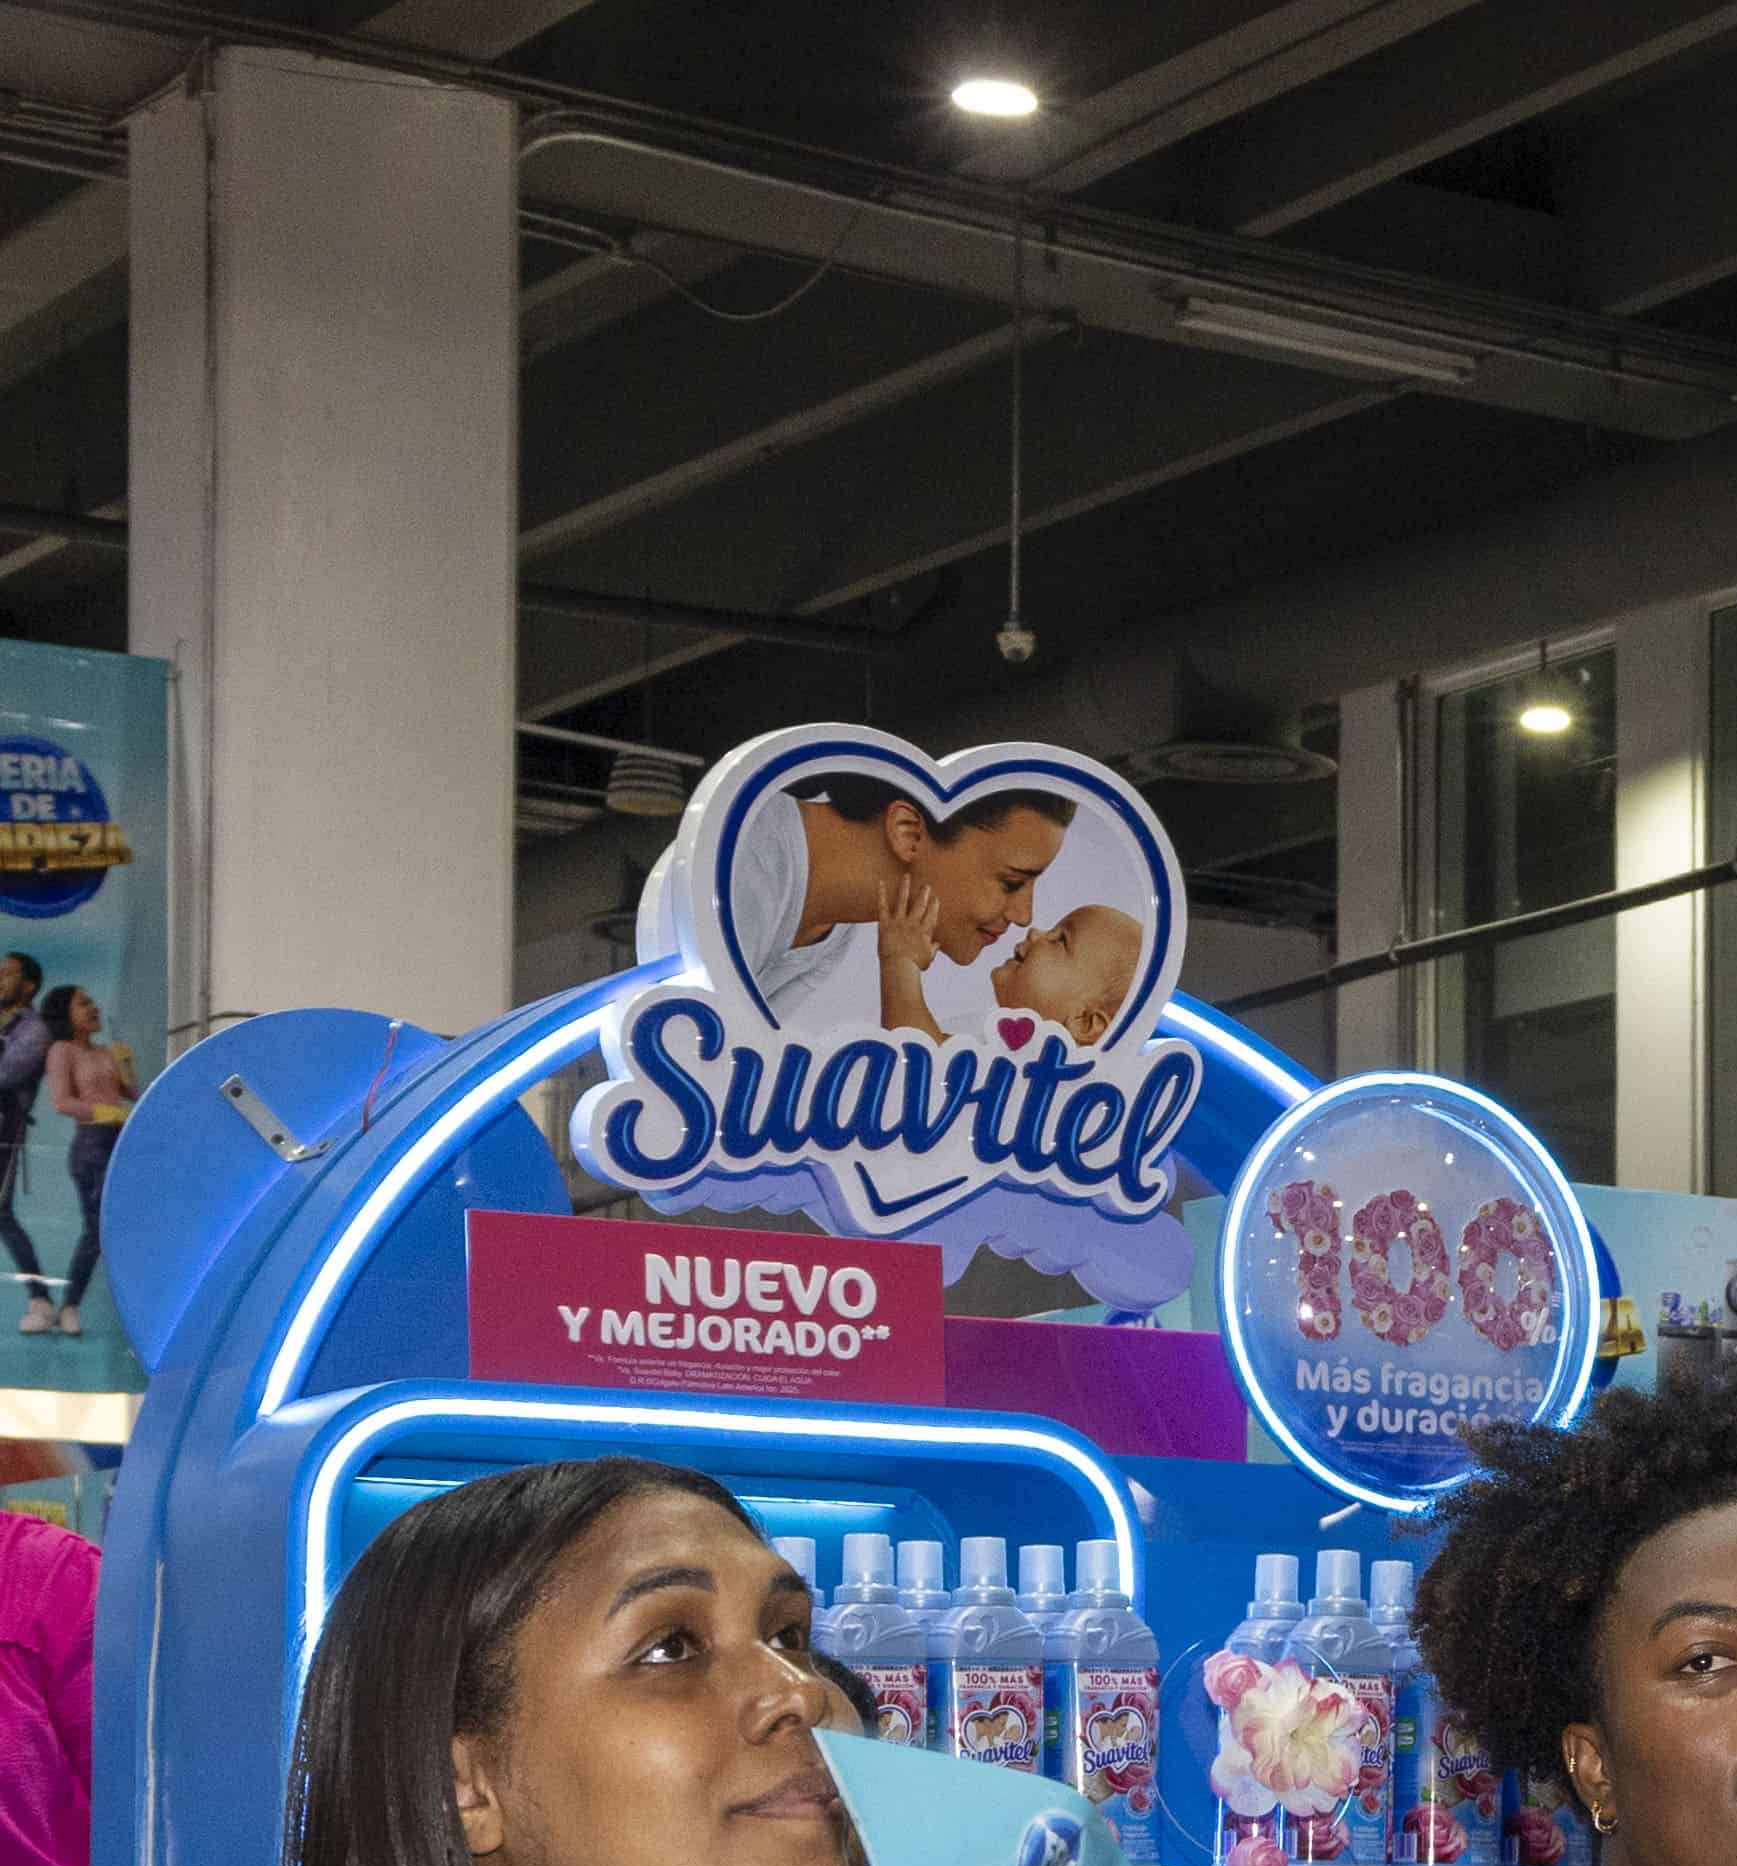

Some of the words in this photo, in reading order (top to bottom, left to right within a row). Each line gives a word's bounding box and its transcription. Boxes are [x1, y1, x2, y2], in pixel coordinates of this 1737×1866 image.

[0, 752, 87, 792] ERIA
[10, 792, 56, 820] DE
[606, 997, 1195, 1202] Suavitel
[645, 1253, 877, 1319] NUEVO
[558, 1306, 591, 1343] Y
[1296, 1357, 1372, 1393] Más
[1380, 1361, 1543, 1404] fragancia
[1328, 1405, 1348, 1437] y
[1000, 1671, 1024, 1684] MÁS
[1083, 1740, 1154, 1774] Suavitel
